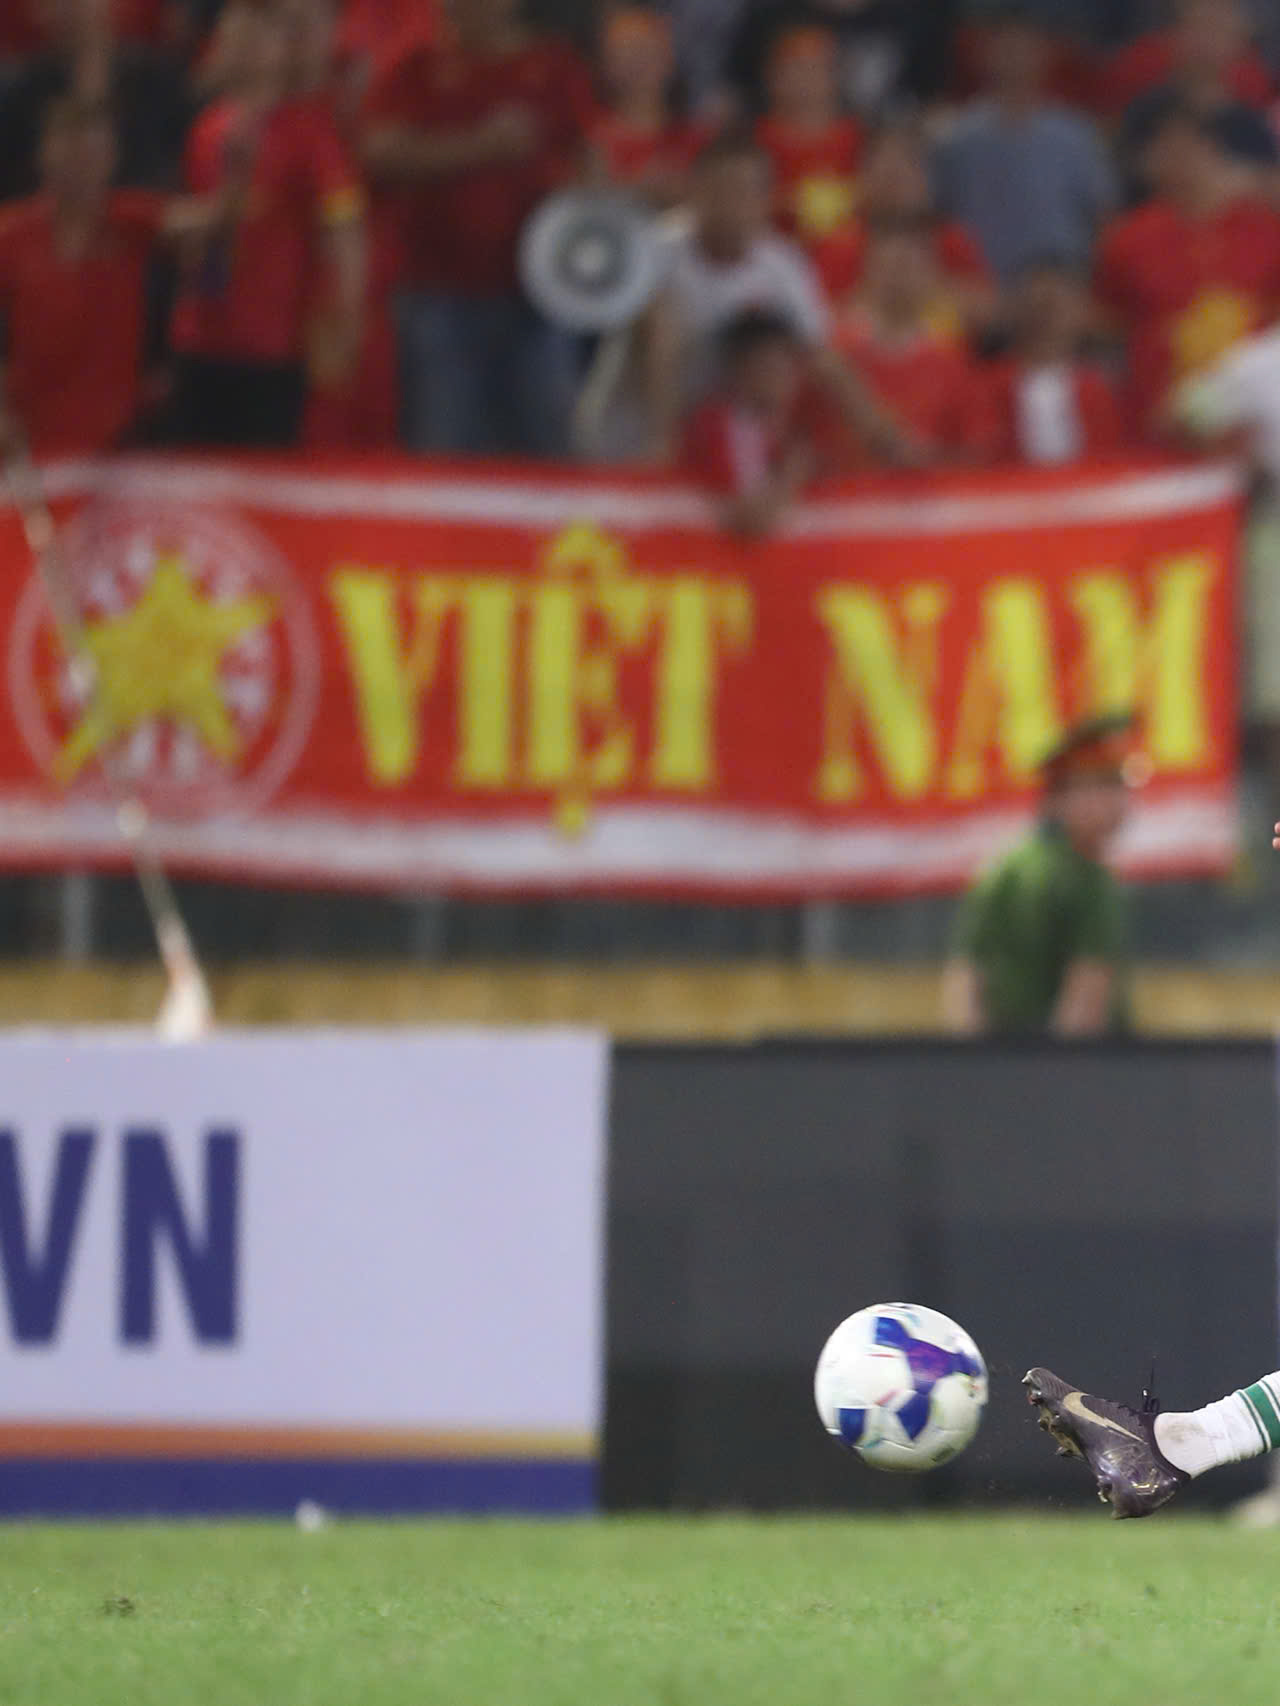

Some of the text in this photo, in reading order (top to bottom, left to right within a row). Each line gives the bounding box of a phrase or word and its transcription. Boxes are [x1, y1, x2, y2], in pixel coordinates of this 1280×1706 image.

[330, 522, 1215, 838] VIỆT NAM
[0, 1127, 241, 1349] VN
